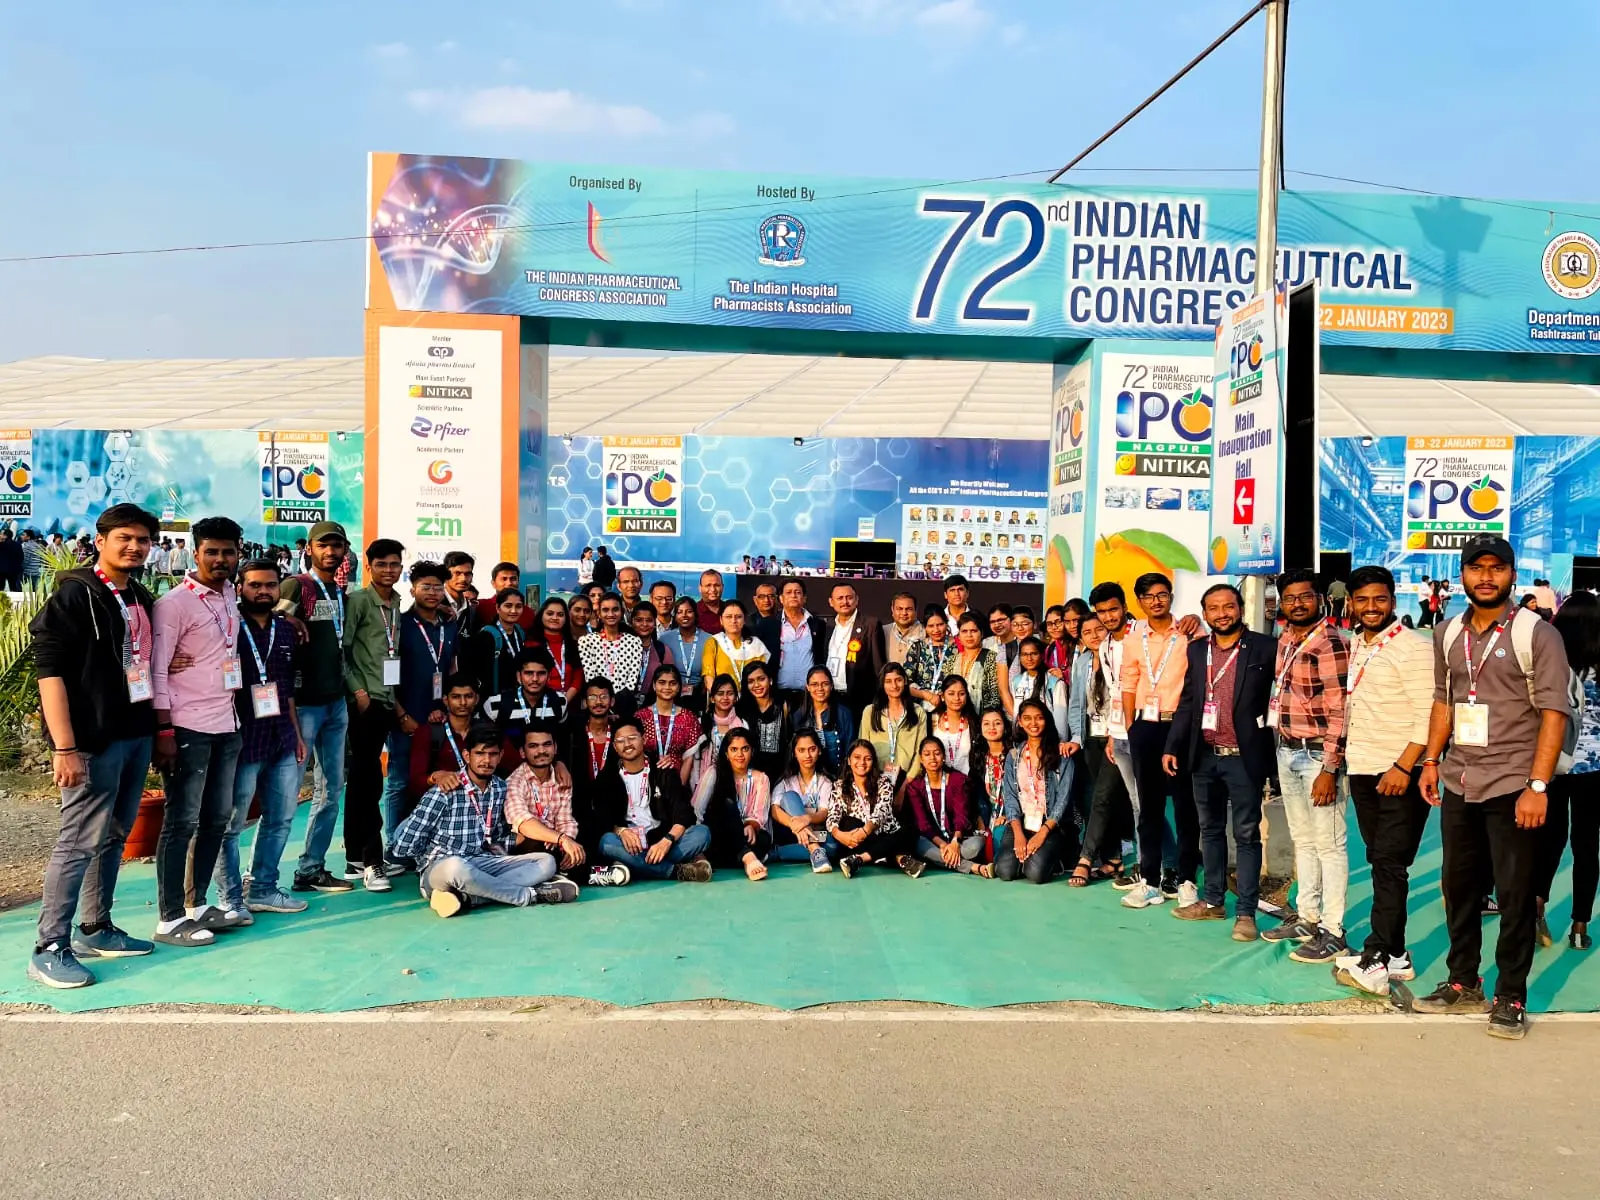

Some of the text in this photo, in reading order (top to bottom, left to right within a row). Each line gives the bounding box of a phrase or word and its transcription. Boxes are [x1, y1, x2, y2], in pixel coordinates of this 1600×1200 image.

[570, 175, 642, 192] Organised By
[757, 185, 816, 202] Hosted By
[1074, 201, 1200, 240] INDIAN
[1072, 244, 1412, 290] PHARMACUTICAL
[526, 270, 680, 290] THE INDIAN PHARMACEUTICAL
[540, 288, 666, 306] CONGRESS ASSOCIATION
[730, 280, 838, 298] The Indian Hospital
[714, 297, 852, 314] Pharmacists Association
[1070, 286, 1254, 326] CONGRES
[1337, 310, 1404, 328] JANUARY
[1412, 312, 1448, 330] 2023
[1530, 328, 1586, 340] Rashtrasant
[1153, 366, 1178, 374] INDIAN
[426, 387, 470, 397] NITIKA
[1152, 382, 1192, 390] CONGRESS
[1238, 384, 1260, 400] NITIKA
[1234, 411, 1254, 433] Main
[434, 422, 470, 440] Pfizer
[1132, 443, 1200, 453] NAGPUR
[1218, 428, 1272, 458] Inauguration
[1414, 438, 1424, 448] 20
[1442, 438, 1482, 448] JANUARY
[1486, 438, 1506, 448] 2023
[1060, 464, 1080, 481] NITIKA
[1143, 458, 1210, 474] NITIKA
[1236, 458, 1252, 479] Hall
[1442, 470, 1480, 478] CONGRESS
[281, 510, 322, 520] NITIKA
[626, 520, 672, 530] NITIKA
[1424, 522, 1488, 530] NAGPUR
[1433, 535, 1472, 548] NITI
